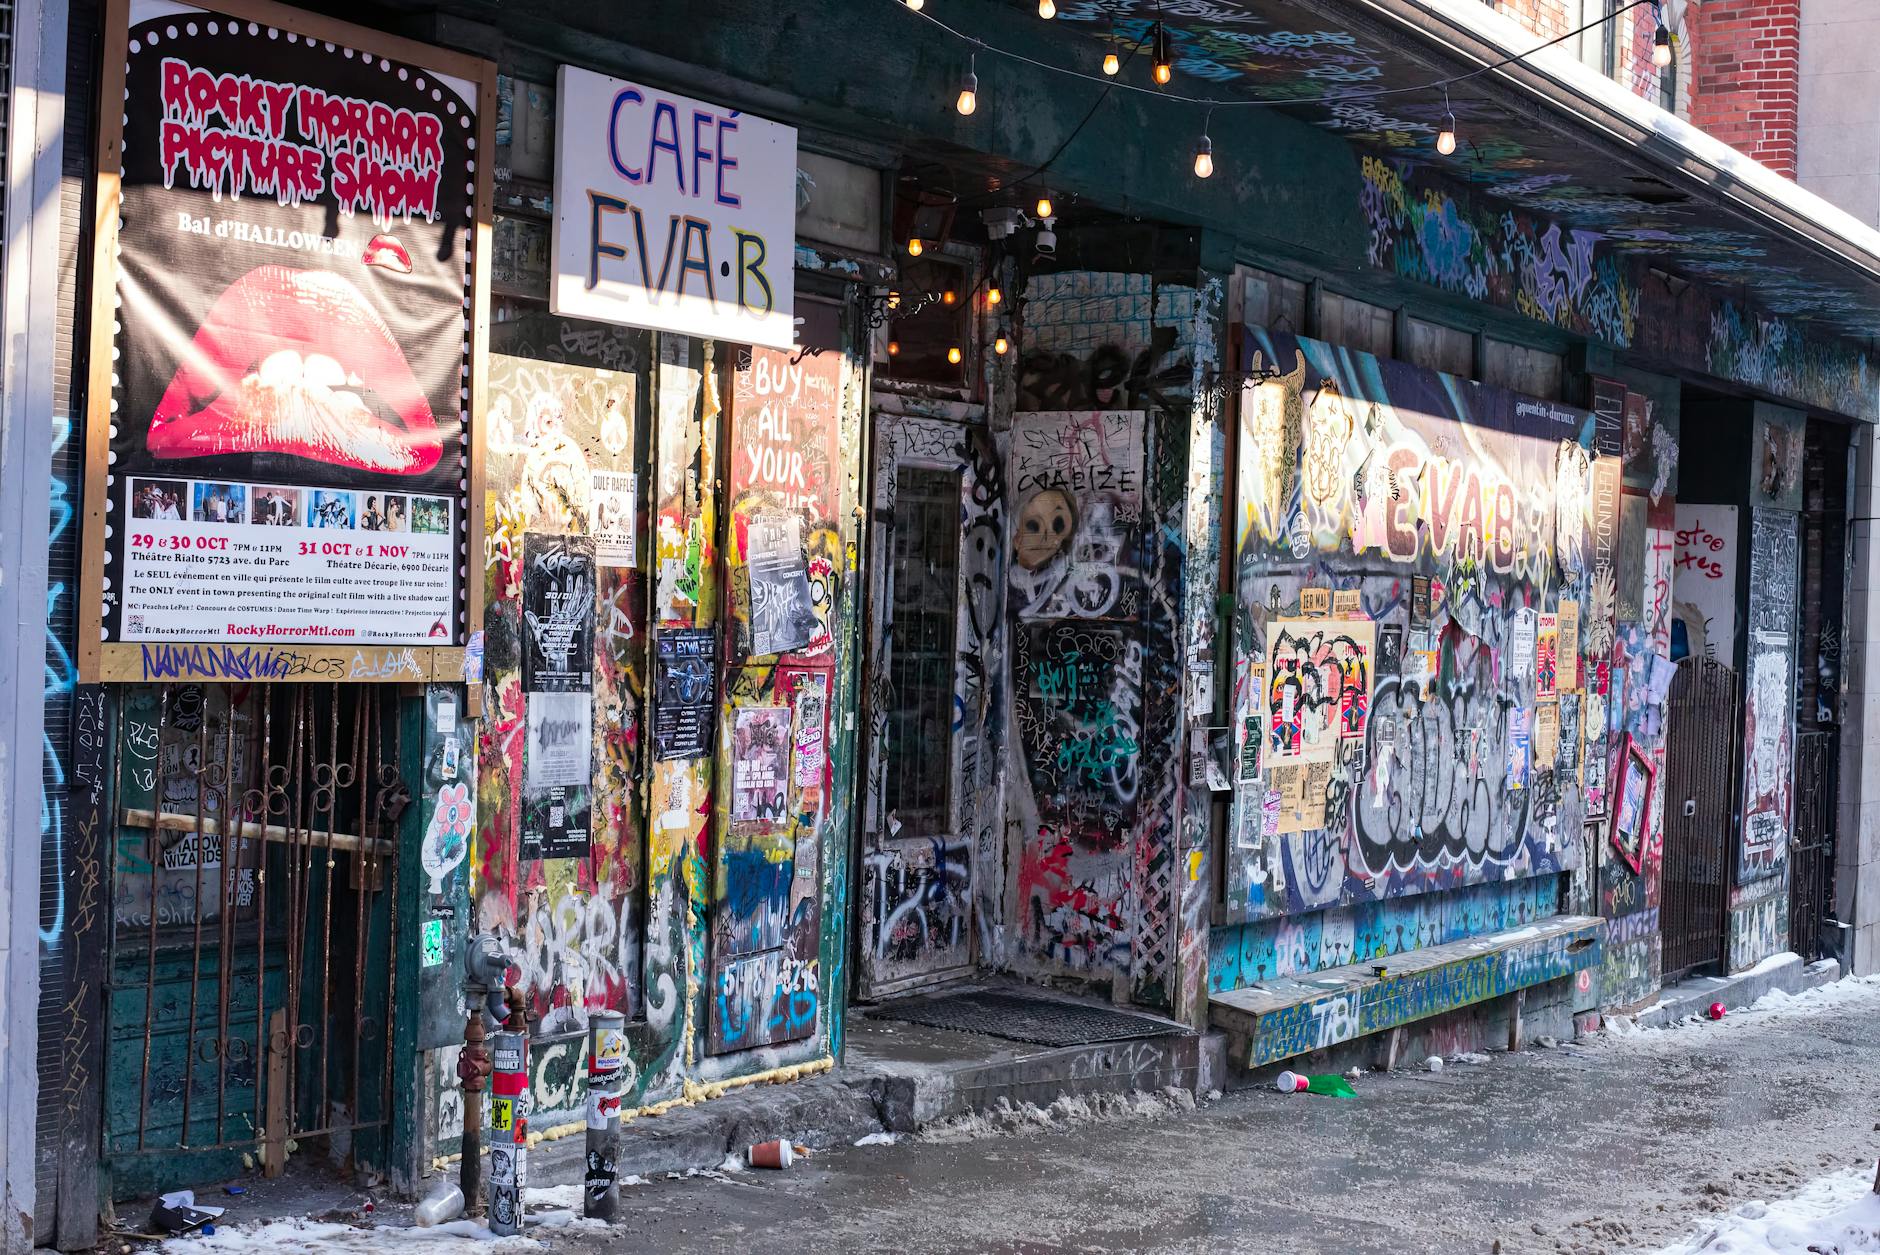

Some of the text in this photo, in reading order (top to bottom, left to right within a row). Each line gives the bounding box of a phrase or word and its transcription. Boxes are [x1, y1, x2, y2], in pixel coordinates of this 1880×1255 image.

[161, 57, 444, 172] ROCKY HORROR
[607, 86, 742, 209] CAFÉ
[160, 119, 441, 232] PICTURE SHOW
[177, 212, 210, 236] Bal
[755, 357, 803, 404] BUY
[759, 406, 792, 441] ALL
[747, 444, 806, 488] YOUR
[612, 477, 634, 492] RAFFLE
[131, 533, 154, 549] 29
[158, 538, 167, 548] &
[170, 535, 191, 550] 30
[196, 537, 229, 550] OCT
[233, 543, 250, 551] 7PM
[259, 545, 282, 553] 11PM
[298, 542, 317, 556] 31
[321, 543, 352, 556] OCT
[355, 547, 363, 556] &
[366, 545, 374, 557] 1
[379, 545, 410, 558] NOV
[412, 551, 426, 559] 7PM
[432, 552, 449, 560] 11PM
[131, 551, 172, 562] Théâtre
[174, 553, 205, 563] Rialto
[207, 556, 230, 565] 5723
[254, 557, 266, 566] du
[269, 558, 290, 566] Parc
[364, 560, 400, 572] Décarie,
[401, 563, 420, 572] 6900
[422, 564, 449, 573] Décarie
[134, 570, 145, 578] Le
[146, 570, 172, 579] SEUL
[233, 573, 252, 582] ville
[253, 574, 267, 583] qui
[269, 574, 304, 585] présente
[306, 576, 313, 584] le
[373, 579, 398, 588] troupe
[400, 579, 413, 587] live
[130, 586, 147, 594] The
[149, 586, 175, 595] ONLY
[202, 588, 211, 596] in
[237, 590, 281, 599] presenting
[298, 591, 330, 600] original
[331, 592, 347, 600] cult
[348, 592, 365, 600] film
[367, 593, 386, 601] with
[393, 593, 406, 601] live
[408, 594, 433, 602] shadow
[196, 604, 227, 612] Concours
[237, 605, 273, 613] COSTUMES
[227, 623, 355, 637] RockyHorrorMtl.com
[1540, 617, 1555, 627] UTOPIA
[676, 641, 699, 653] EYWA
